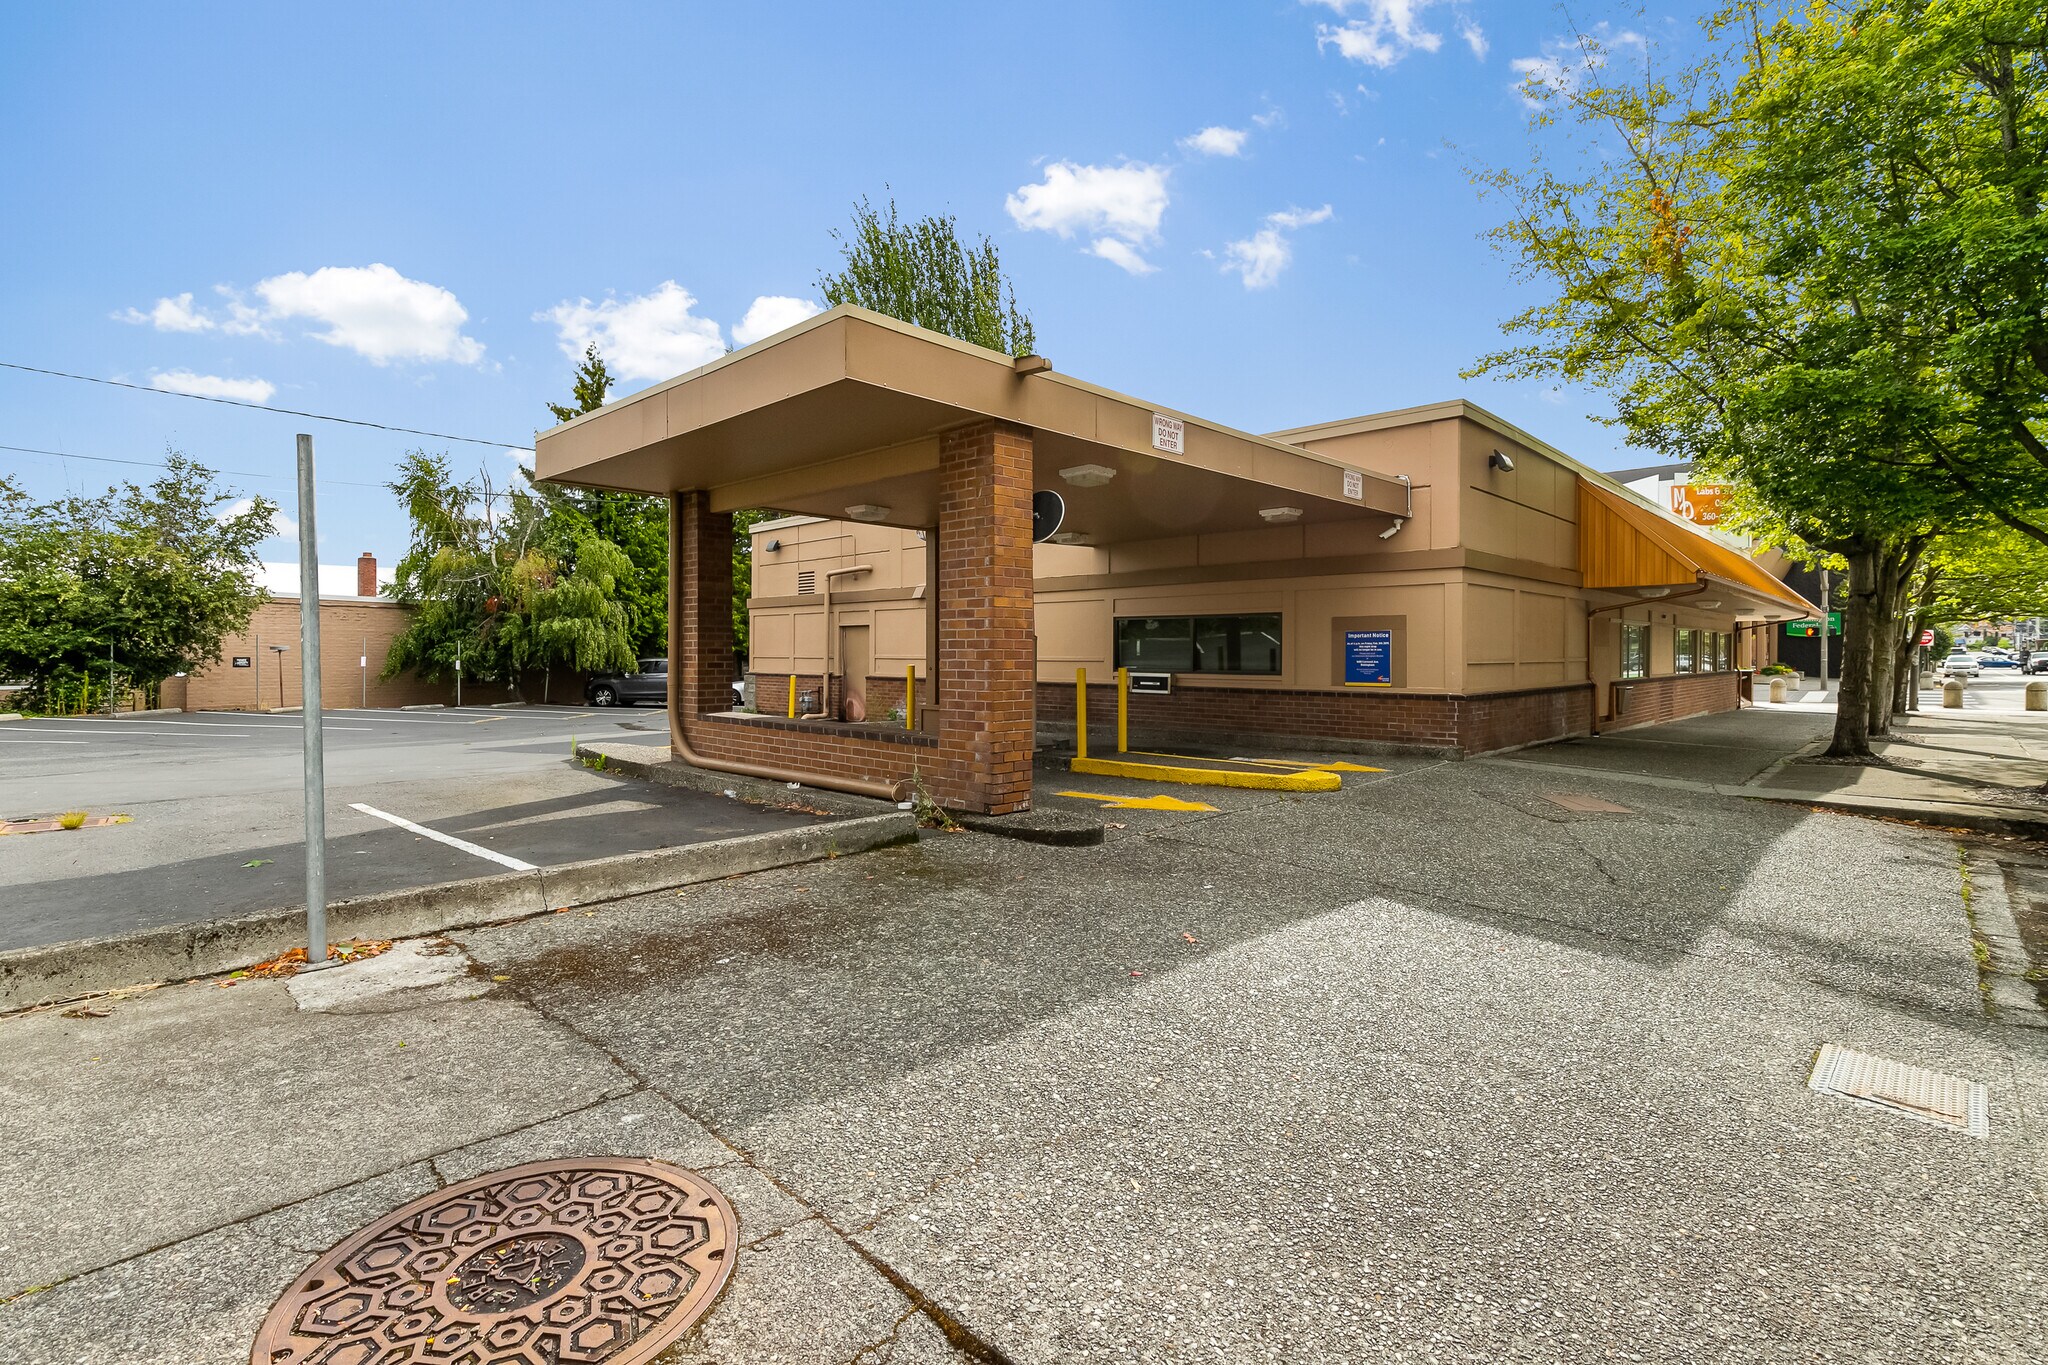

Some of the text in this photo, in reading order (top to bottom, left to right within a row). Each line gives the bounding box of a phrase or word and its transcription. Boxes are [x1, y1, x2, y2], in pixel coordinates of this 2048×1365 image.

[1154, 416, 1183, 431] WRONG WAY
[1158, 427, 1178, 440] DO NOT
[1160, 438, 1178, 449] ENTER
[1696, 487, 1713, 495] Labs
